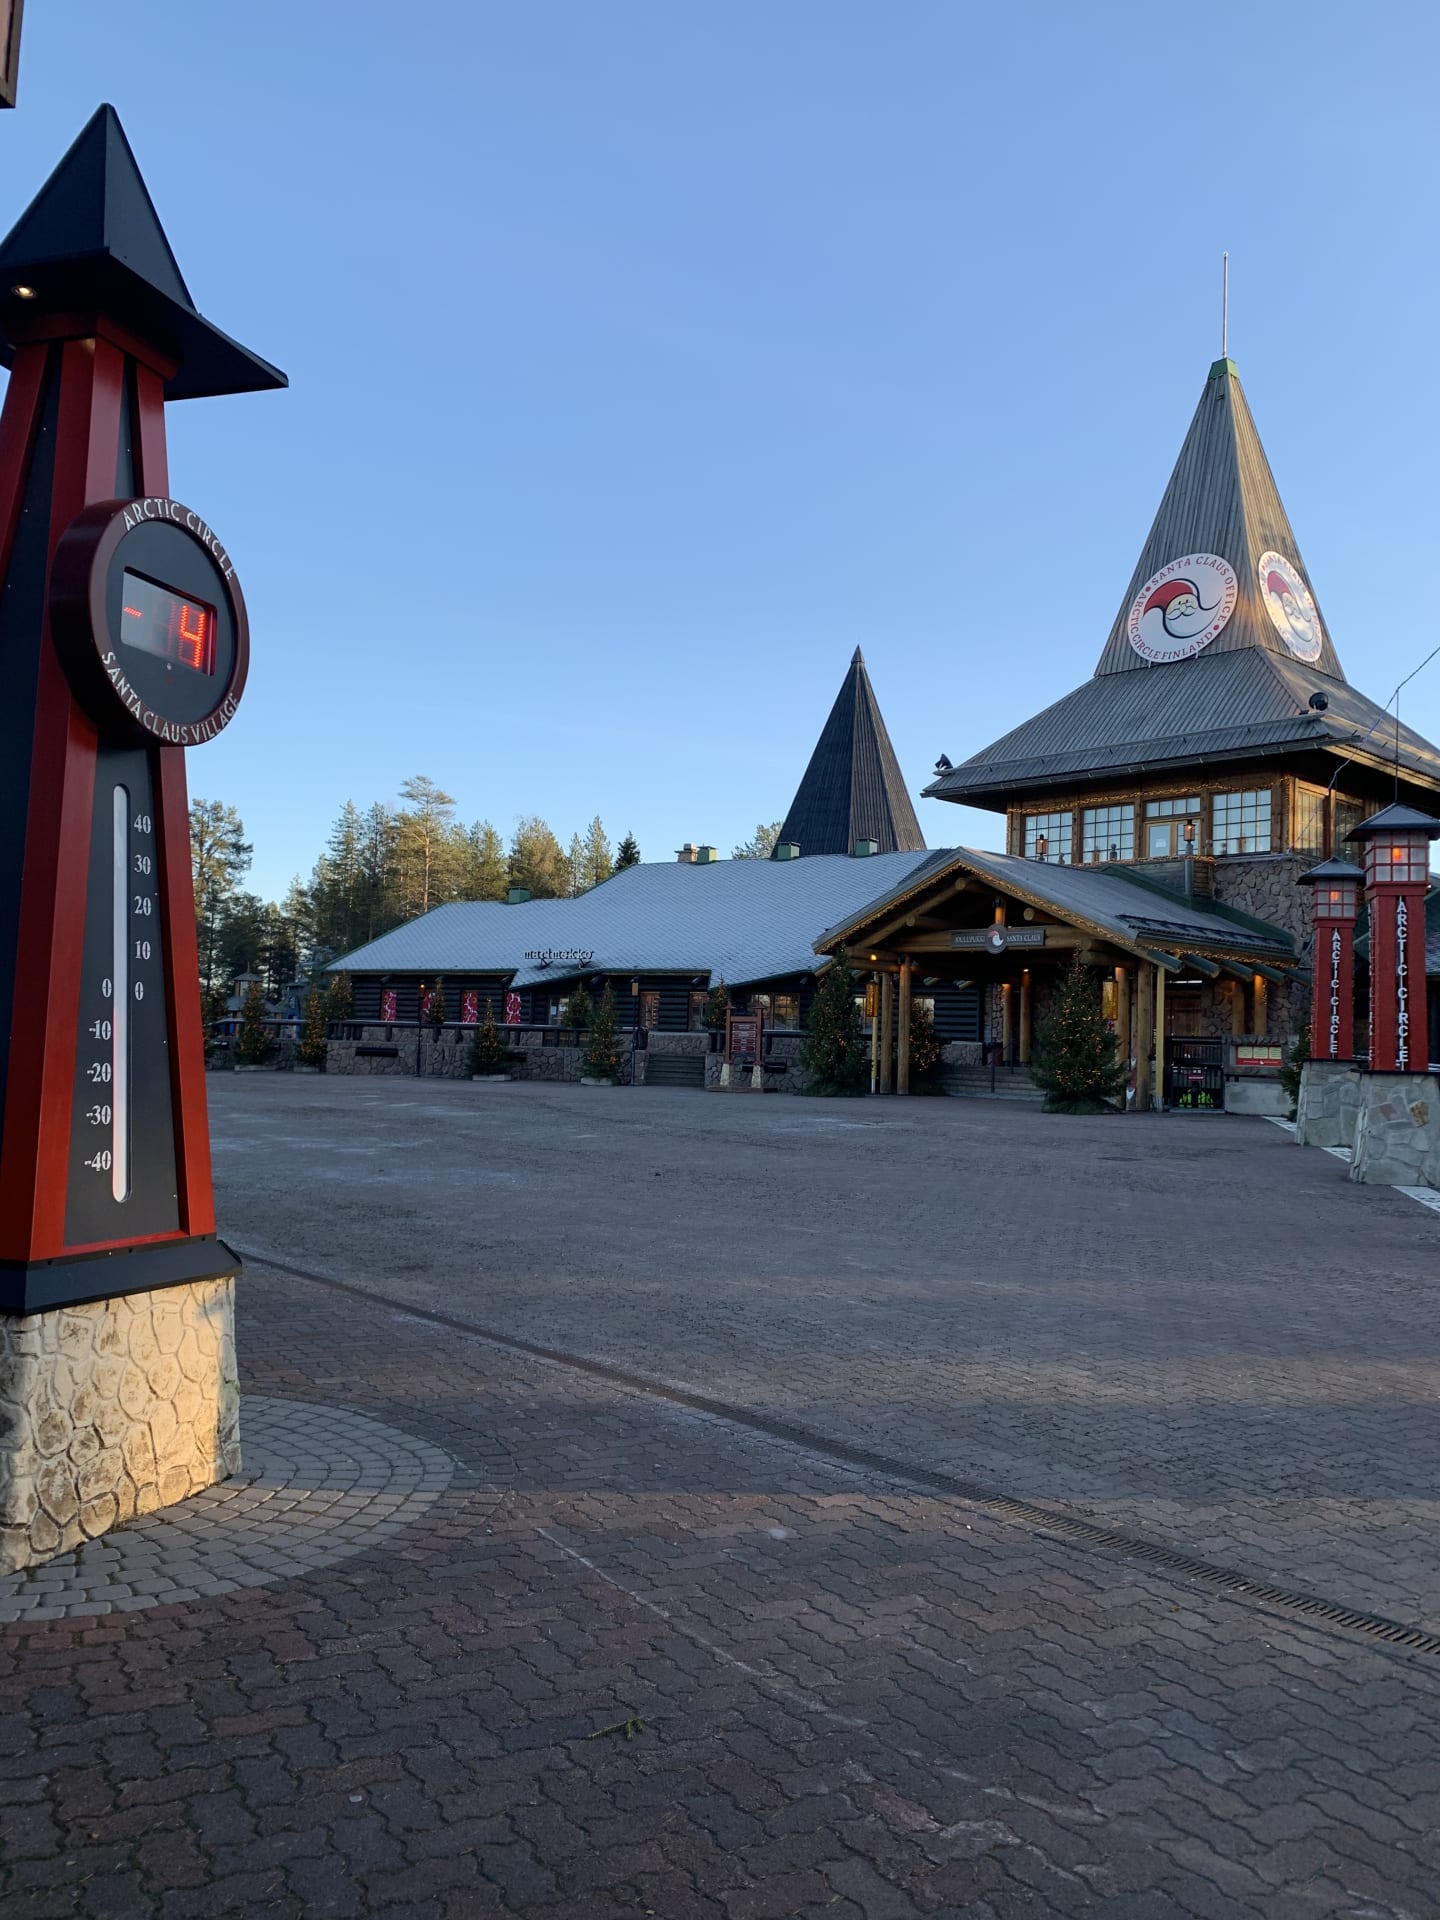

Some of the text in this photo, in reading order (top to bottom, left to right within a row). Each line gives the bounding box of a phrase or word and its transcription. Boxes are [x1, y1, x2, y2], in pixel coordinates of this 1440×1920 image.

[123, 499, 237, 581] ARCTIC CIRCLE
[1152, 556, 1236, 622] SANTA CLAUS OFFICE
[1130, 593, 1213, 660] ARCTIC CIRCLE FINLAND
[101, 651, 239, 744] SANTA CLAUS VILLAGE
[134, 814, 152, 834] 40
[134, 854, 152, 875] 30
[134, 896, 152, 916] 20
[134, 940, 152, 960] 10
[101, 978, 113, 998] 0
[134, 981, 144, 1001] 0
[1330, 931, 1340, 1053] ARCTIC CIRCLE
[1397, 902, 1408, 1061] ARCTIC CIRCLE
[89, 1019, 112, 1040] -10
[87, 1062, 112, 1083] -20
[86, 1104, 112, 1125] -30
[84, 1149, 112, 1171] -40
